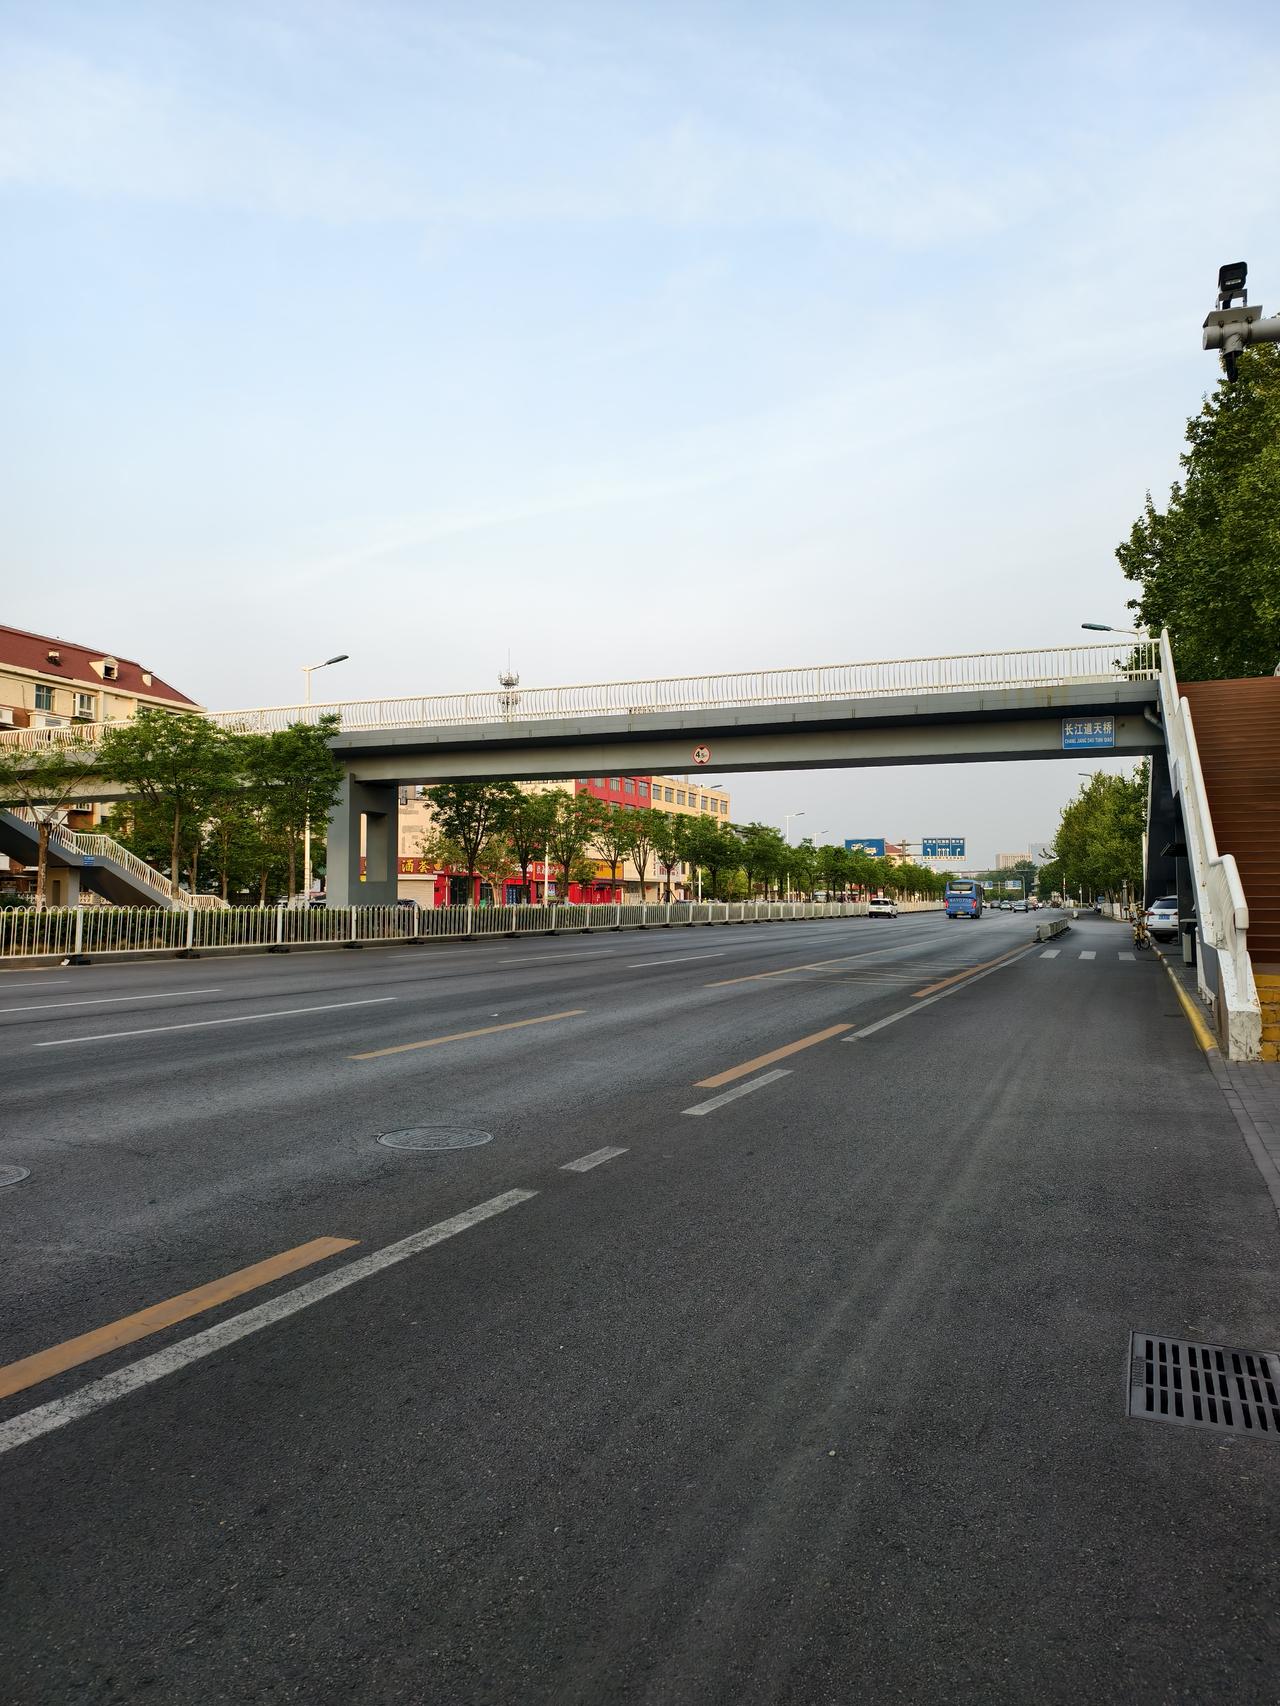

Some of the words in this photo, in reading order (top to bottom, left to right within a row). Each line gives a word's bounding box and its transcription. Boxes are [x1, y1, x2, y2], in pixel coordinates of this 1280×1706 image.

[1064, 721, 1112, 735] 长江道天桥
